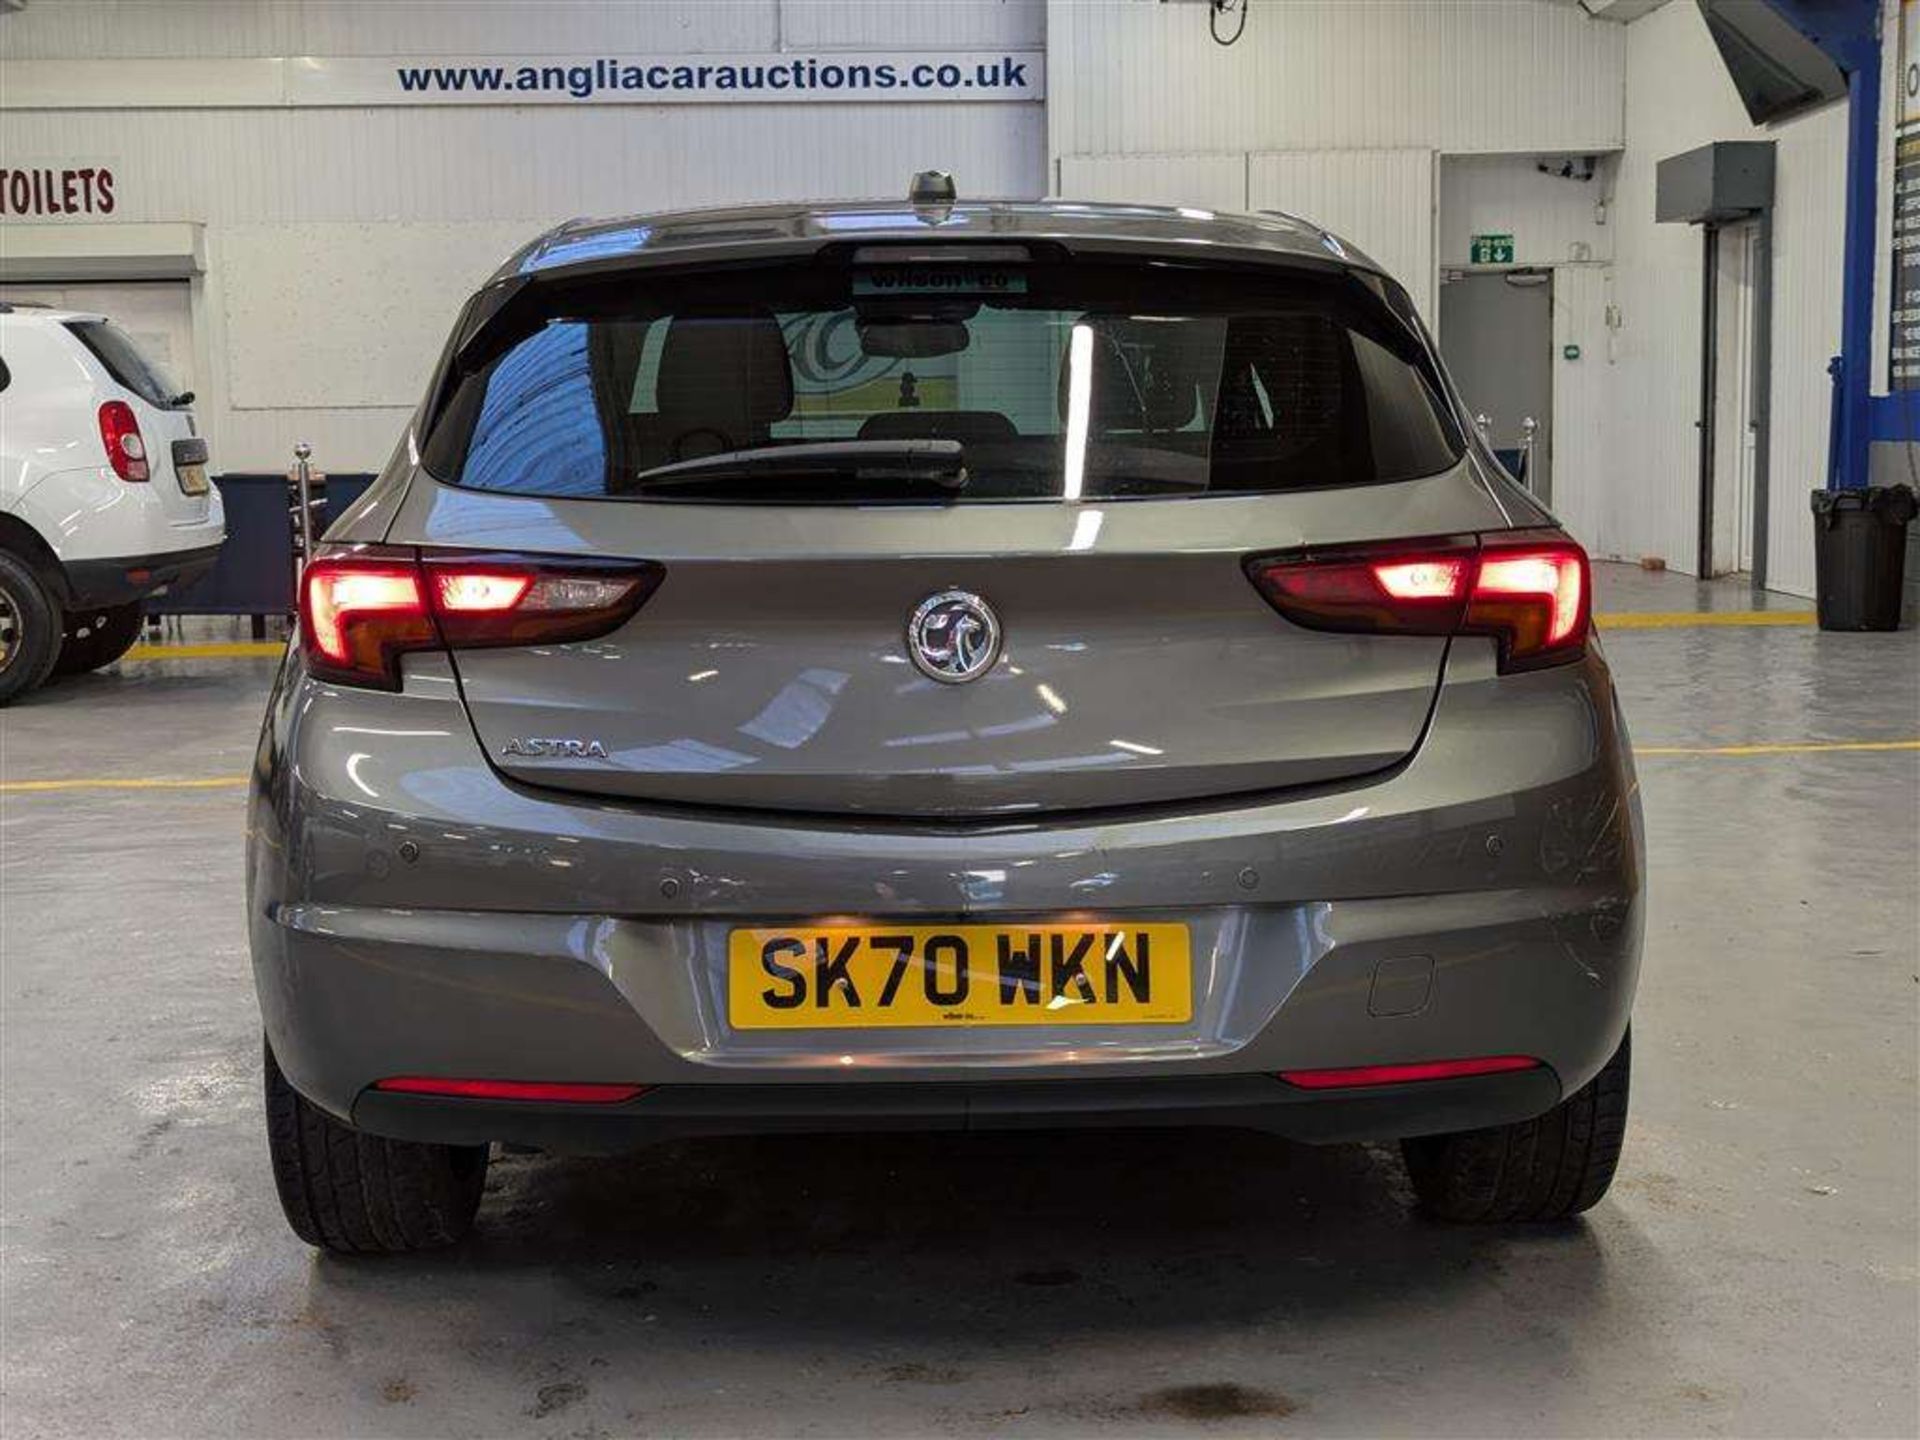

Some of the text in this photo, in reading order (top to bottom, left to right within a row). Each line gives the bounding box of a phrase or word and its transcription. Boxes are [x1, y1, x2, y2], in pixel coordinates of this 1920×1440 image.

[397, 57, 1028, 98] www.angliacarauctions.co.uk
[501, 738, 608, 758] ASTRA
[761, 932, 1151, 1009] SK70 WKN
